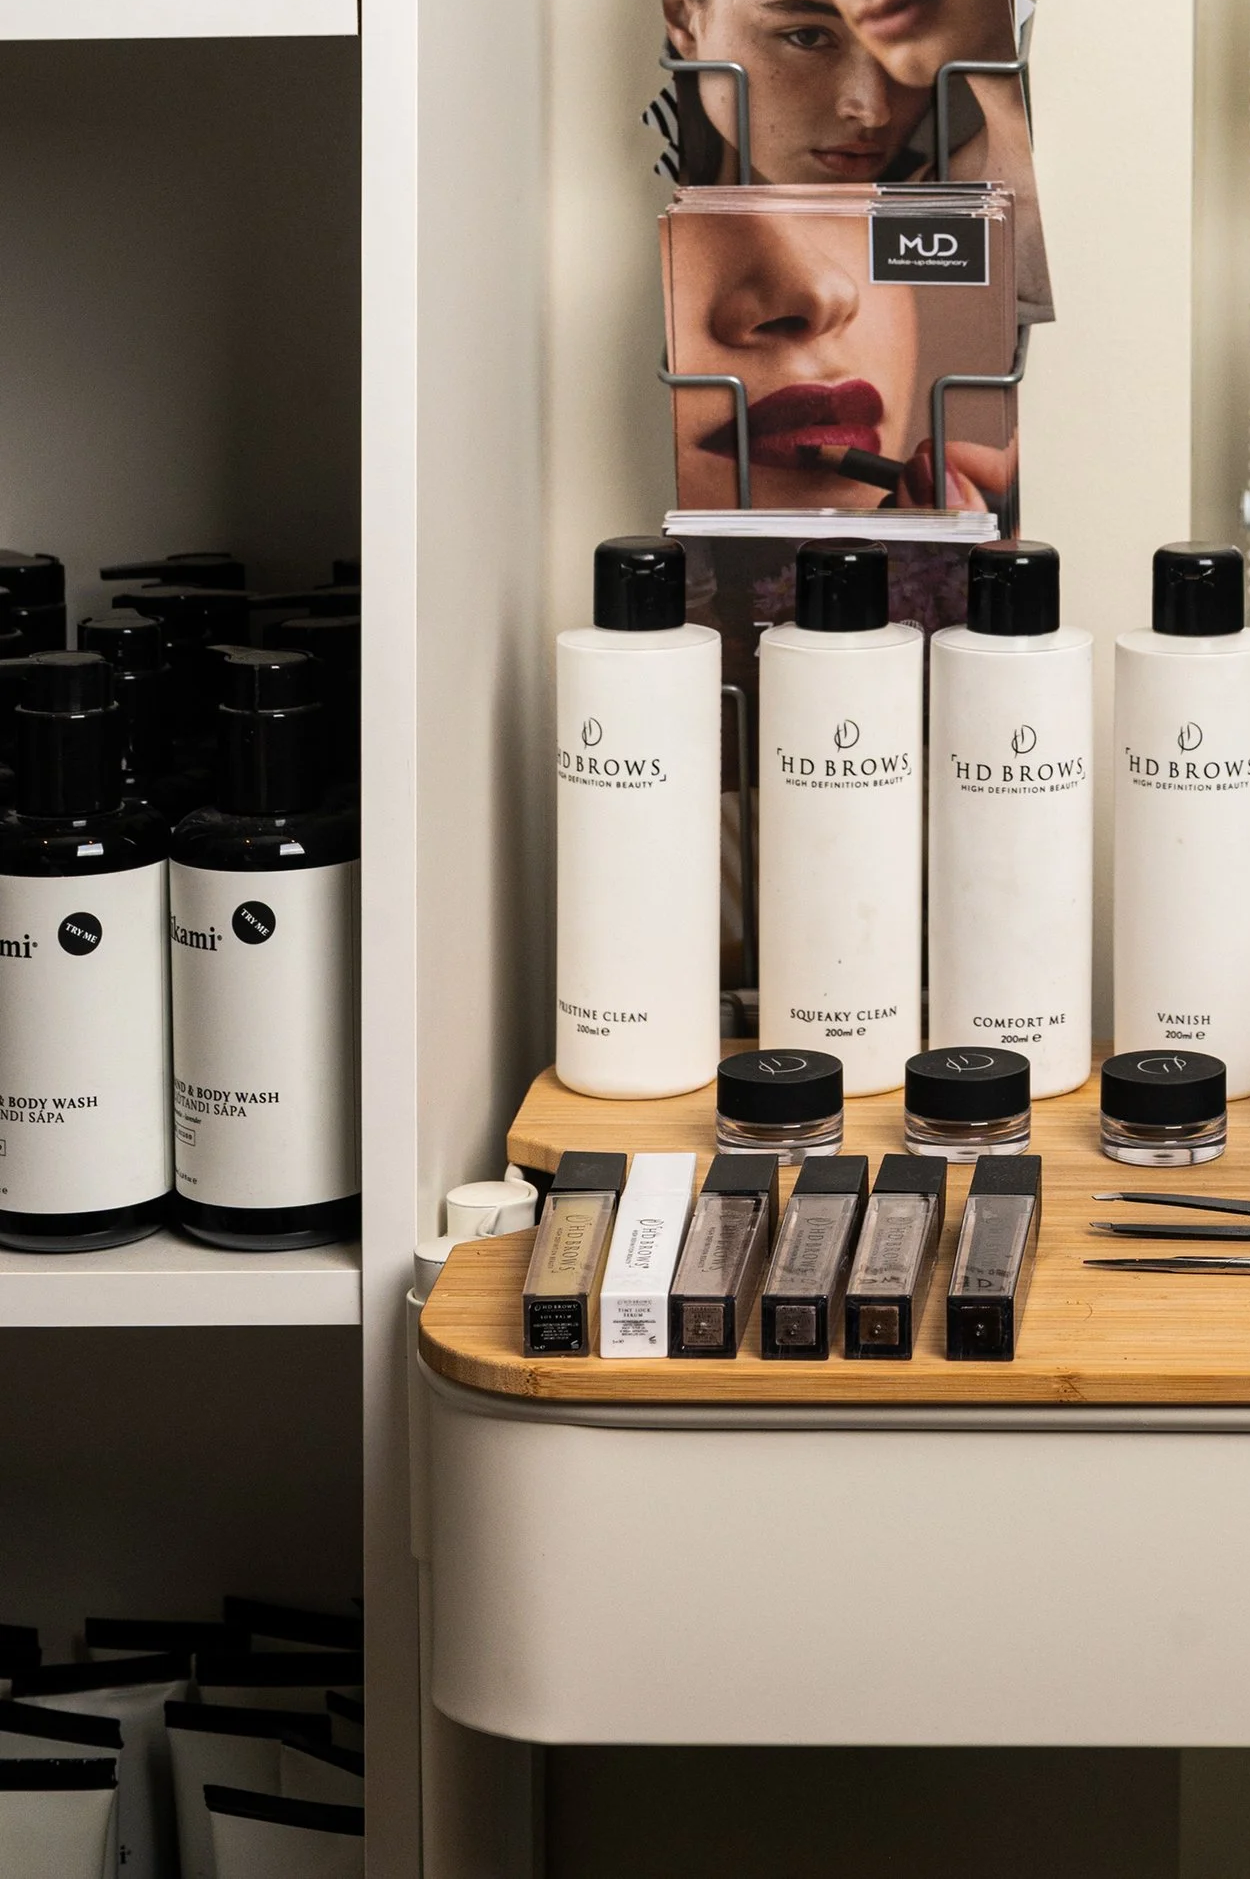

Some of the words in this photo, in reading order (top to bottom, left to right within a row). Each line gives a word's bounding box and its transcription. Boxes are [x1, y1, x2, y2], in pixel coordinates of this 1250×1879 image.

[899, 233, 958, 257] MUD
[576, 755, 661, 777] BROWS
[781, 755, 815, 776] HD
[824, 753, 909, 777] BROWS
[956, 761, 992, 782] HD
[1002, 757, 1083, 782] BROWS
[1129, 755, 1160, 776] HD
[567, 774, 612, 788] DEFINITION
[616, 781, 653, 789] BEAUTY
[785, 778, 808, 787] HIGH
[811, 780, 869, 789] DEFINITION
[961, 784, 984, 793] HIGH
[988, 786, 1046, 794] DEFINITION
[1049, 781, 1079, 793] BEAUTY
[1132, 778, 1153, 787] HIGH
[1155, 781, 1212, 791] DEFINITION
[1216, 781, 1249, 791] BEAUTY
[240, 908, 258, 926] TRY
[254, 922, 270, 937] ME
[65, 922, 84, 937] TRY
[82, 931, 98, 944] ME
[602, 1011, 648, 1023] CLEAN
[790, 1008, 852, 1023] SQUEAKY
[856, 1006, 897, 1021] CLEAN
[972, 1016, 1044, 1028] COMFORT
[1048, 1013, 1067, 1026] ME
[1157, 1012, 1211, 1025] VANISH
[825, 1028, 853, 1037] 200ml
[1000, 1034, 1029, 1043] 200ml
[1165, 1030, 1193, 1040] 200ml
[188, 1084, 194, 1097] &
[196, 1086, 231, 1103] BODY
[235, 1091, 280, 1104] WASH
[8, 1096, 48, 1110] BODY
[52, 1096, 99, 1109] WASH
[213, 1102, 247, 1117] SÁPA
[28, 1109, 65, 1124] SÁPA
[559, 1240, 583, 1272] BROWS
